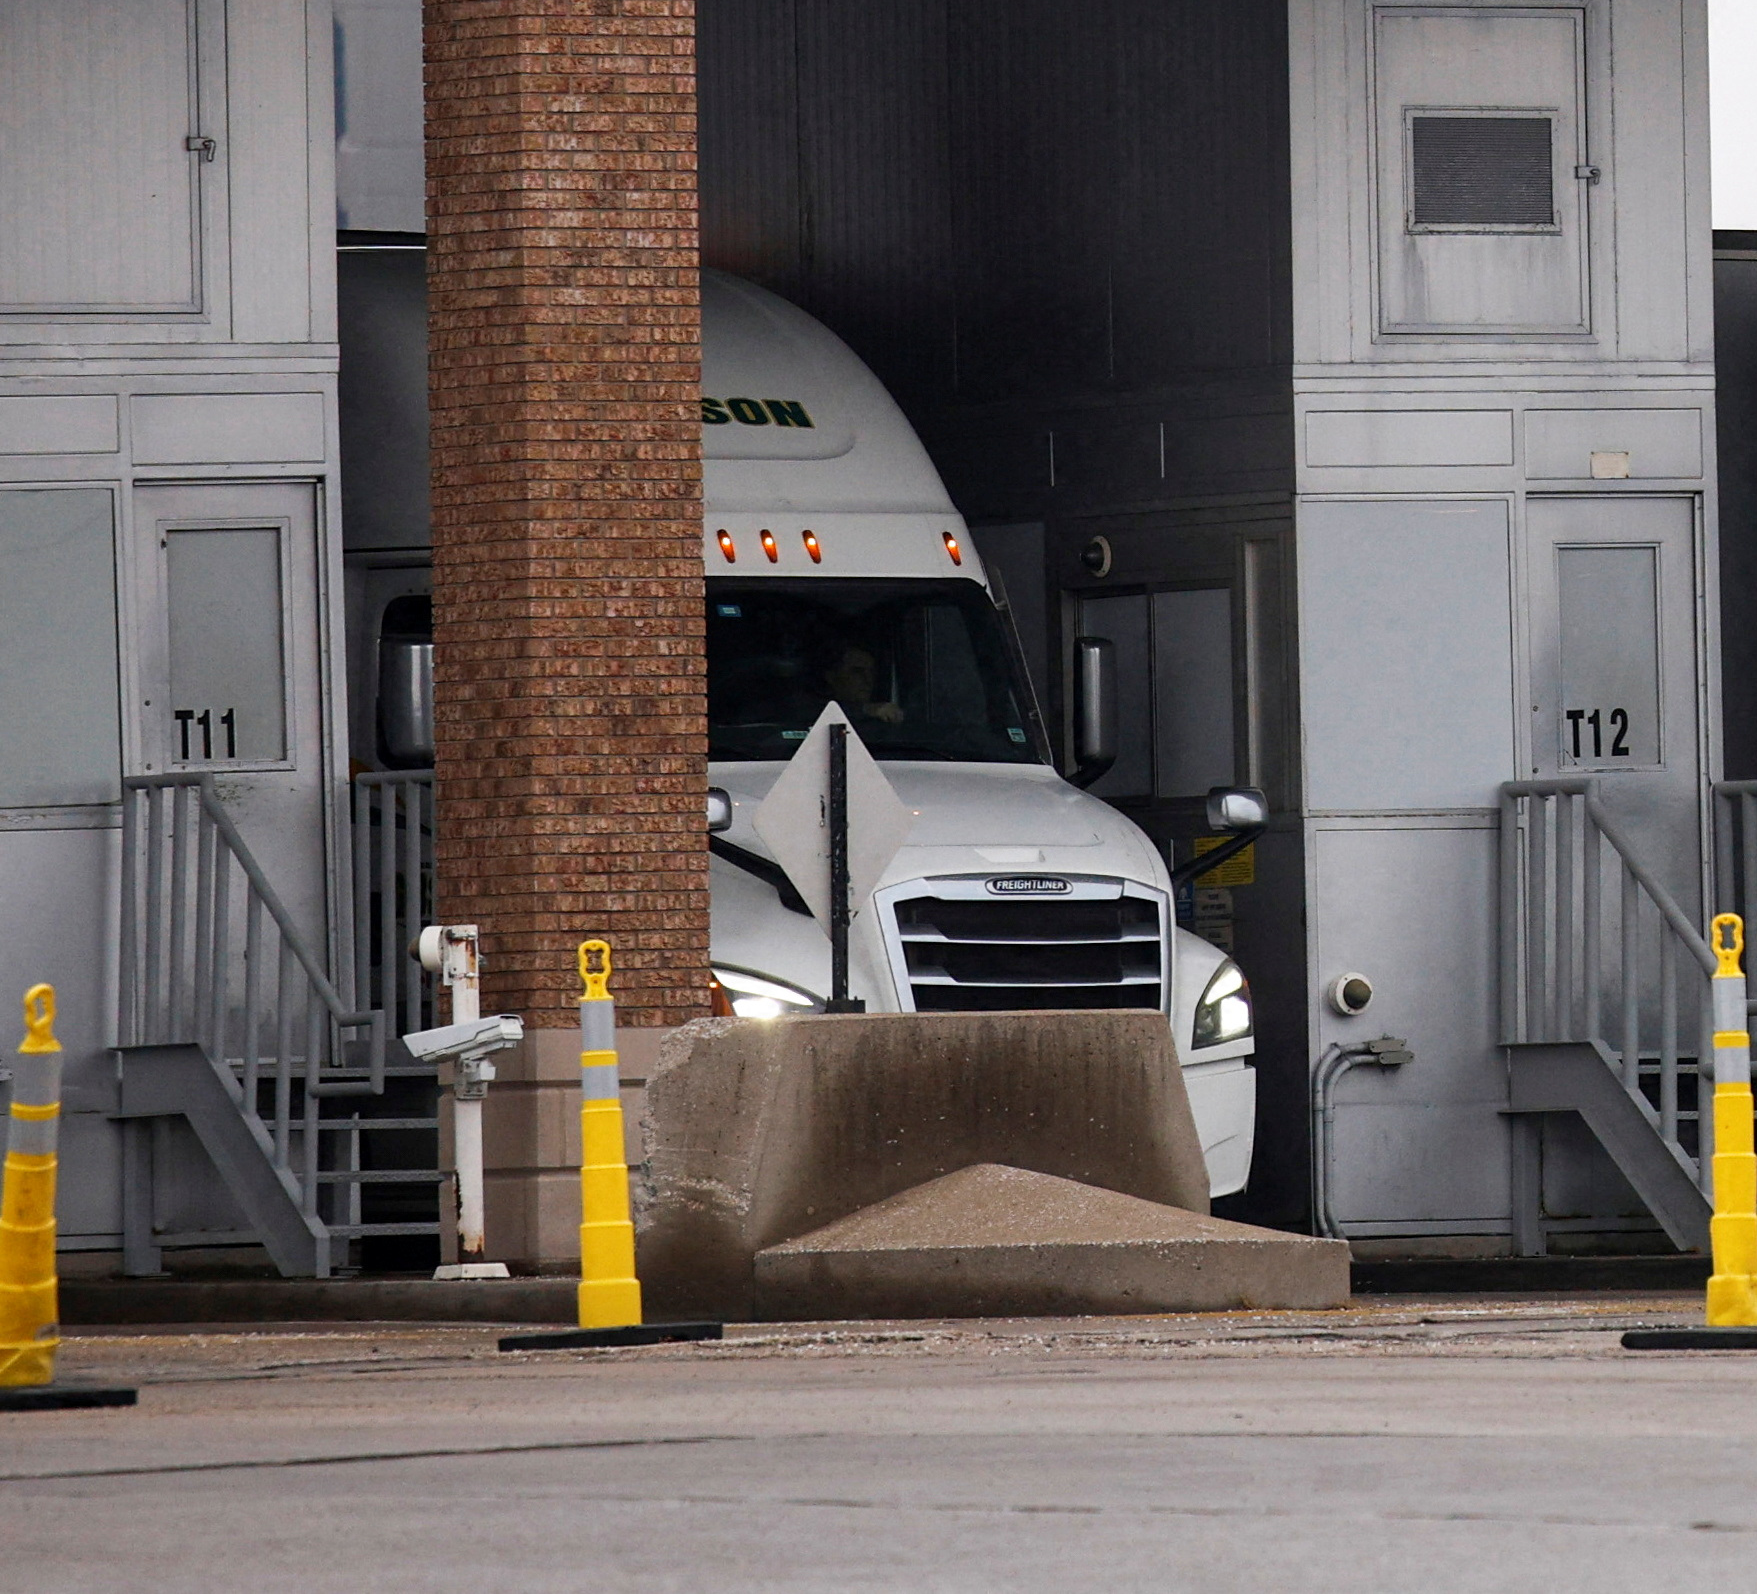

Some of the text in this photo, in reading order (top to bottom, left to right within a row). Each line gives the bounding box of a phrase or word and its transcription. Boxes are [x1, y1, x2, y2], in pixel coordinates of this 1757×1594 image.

[174, 707, 236, 760] T11
[1566, 707, 1630, 759] T12
[995, 879, 1065, 890] FREIGHTLINER
